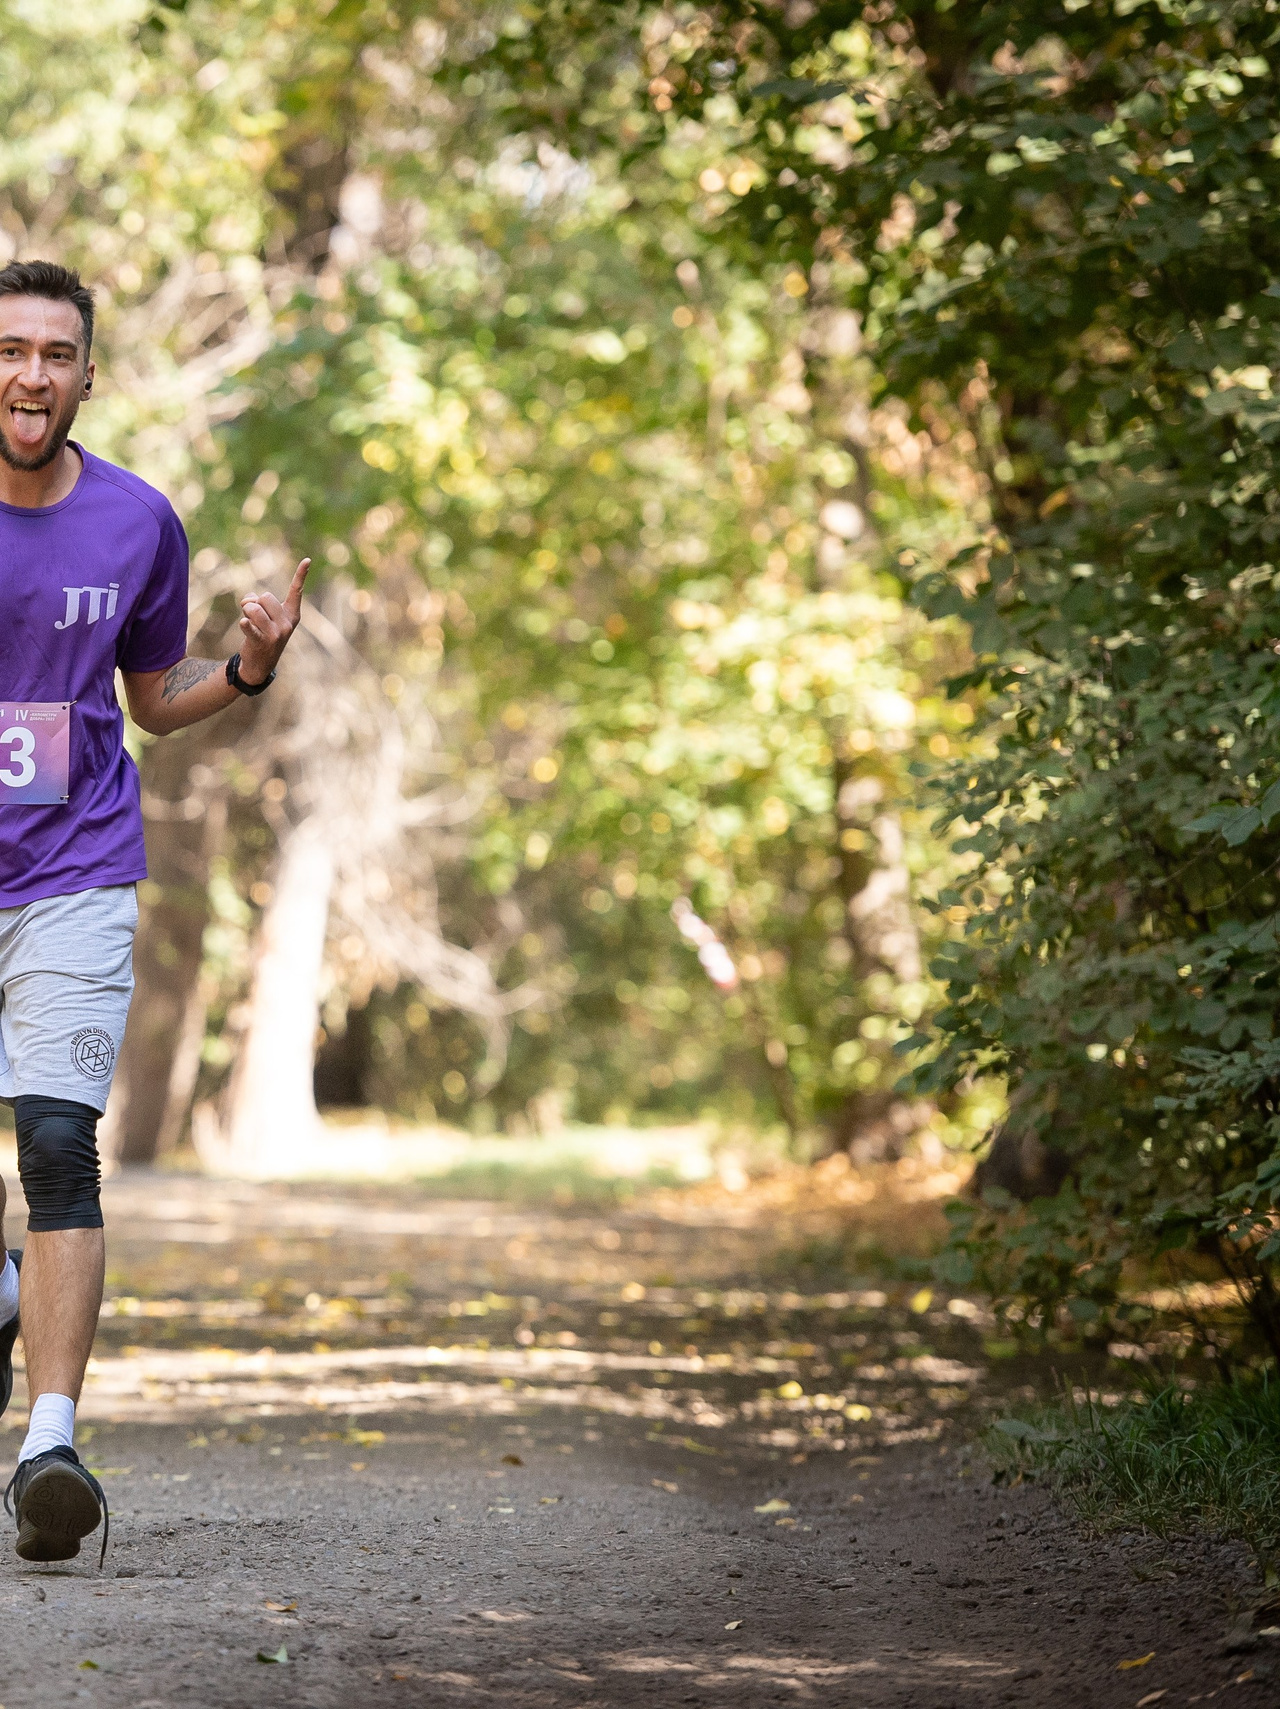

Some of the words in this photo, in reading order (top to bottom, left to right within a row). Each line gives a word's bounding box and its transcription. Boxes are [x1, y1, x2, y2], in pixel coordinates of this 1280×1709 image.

[15, 709, 29, 721] IV
[71, 1028, 92, 1046] BRKLYN
[92, 1028, 114, 1047] DISTRICT
